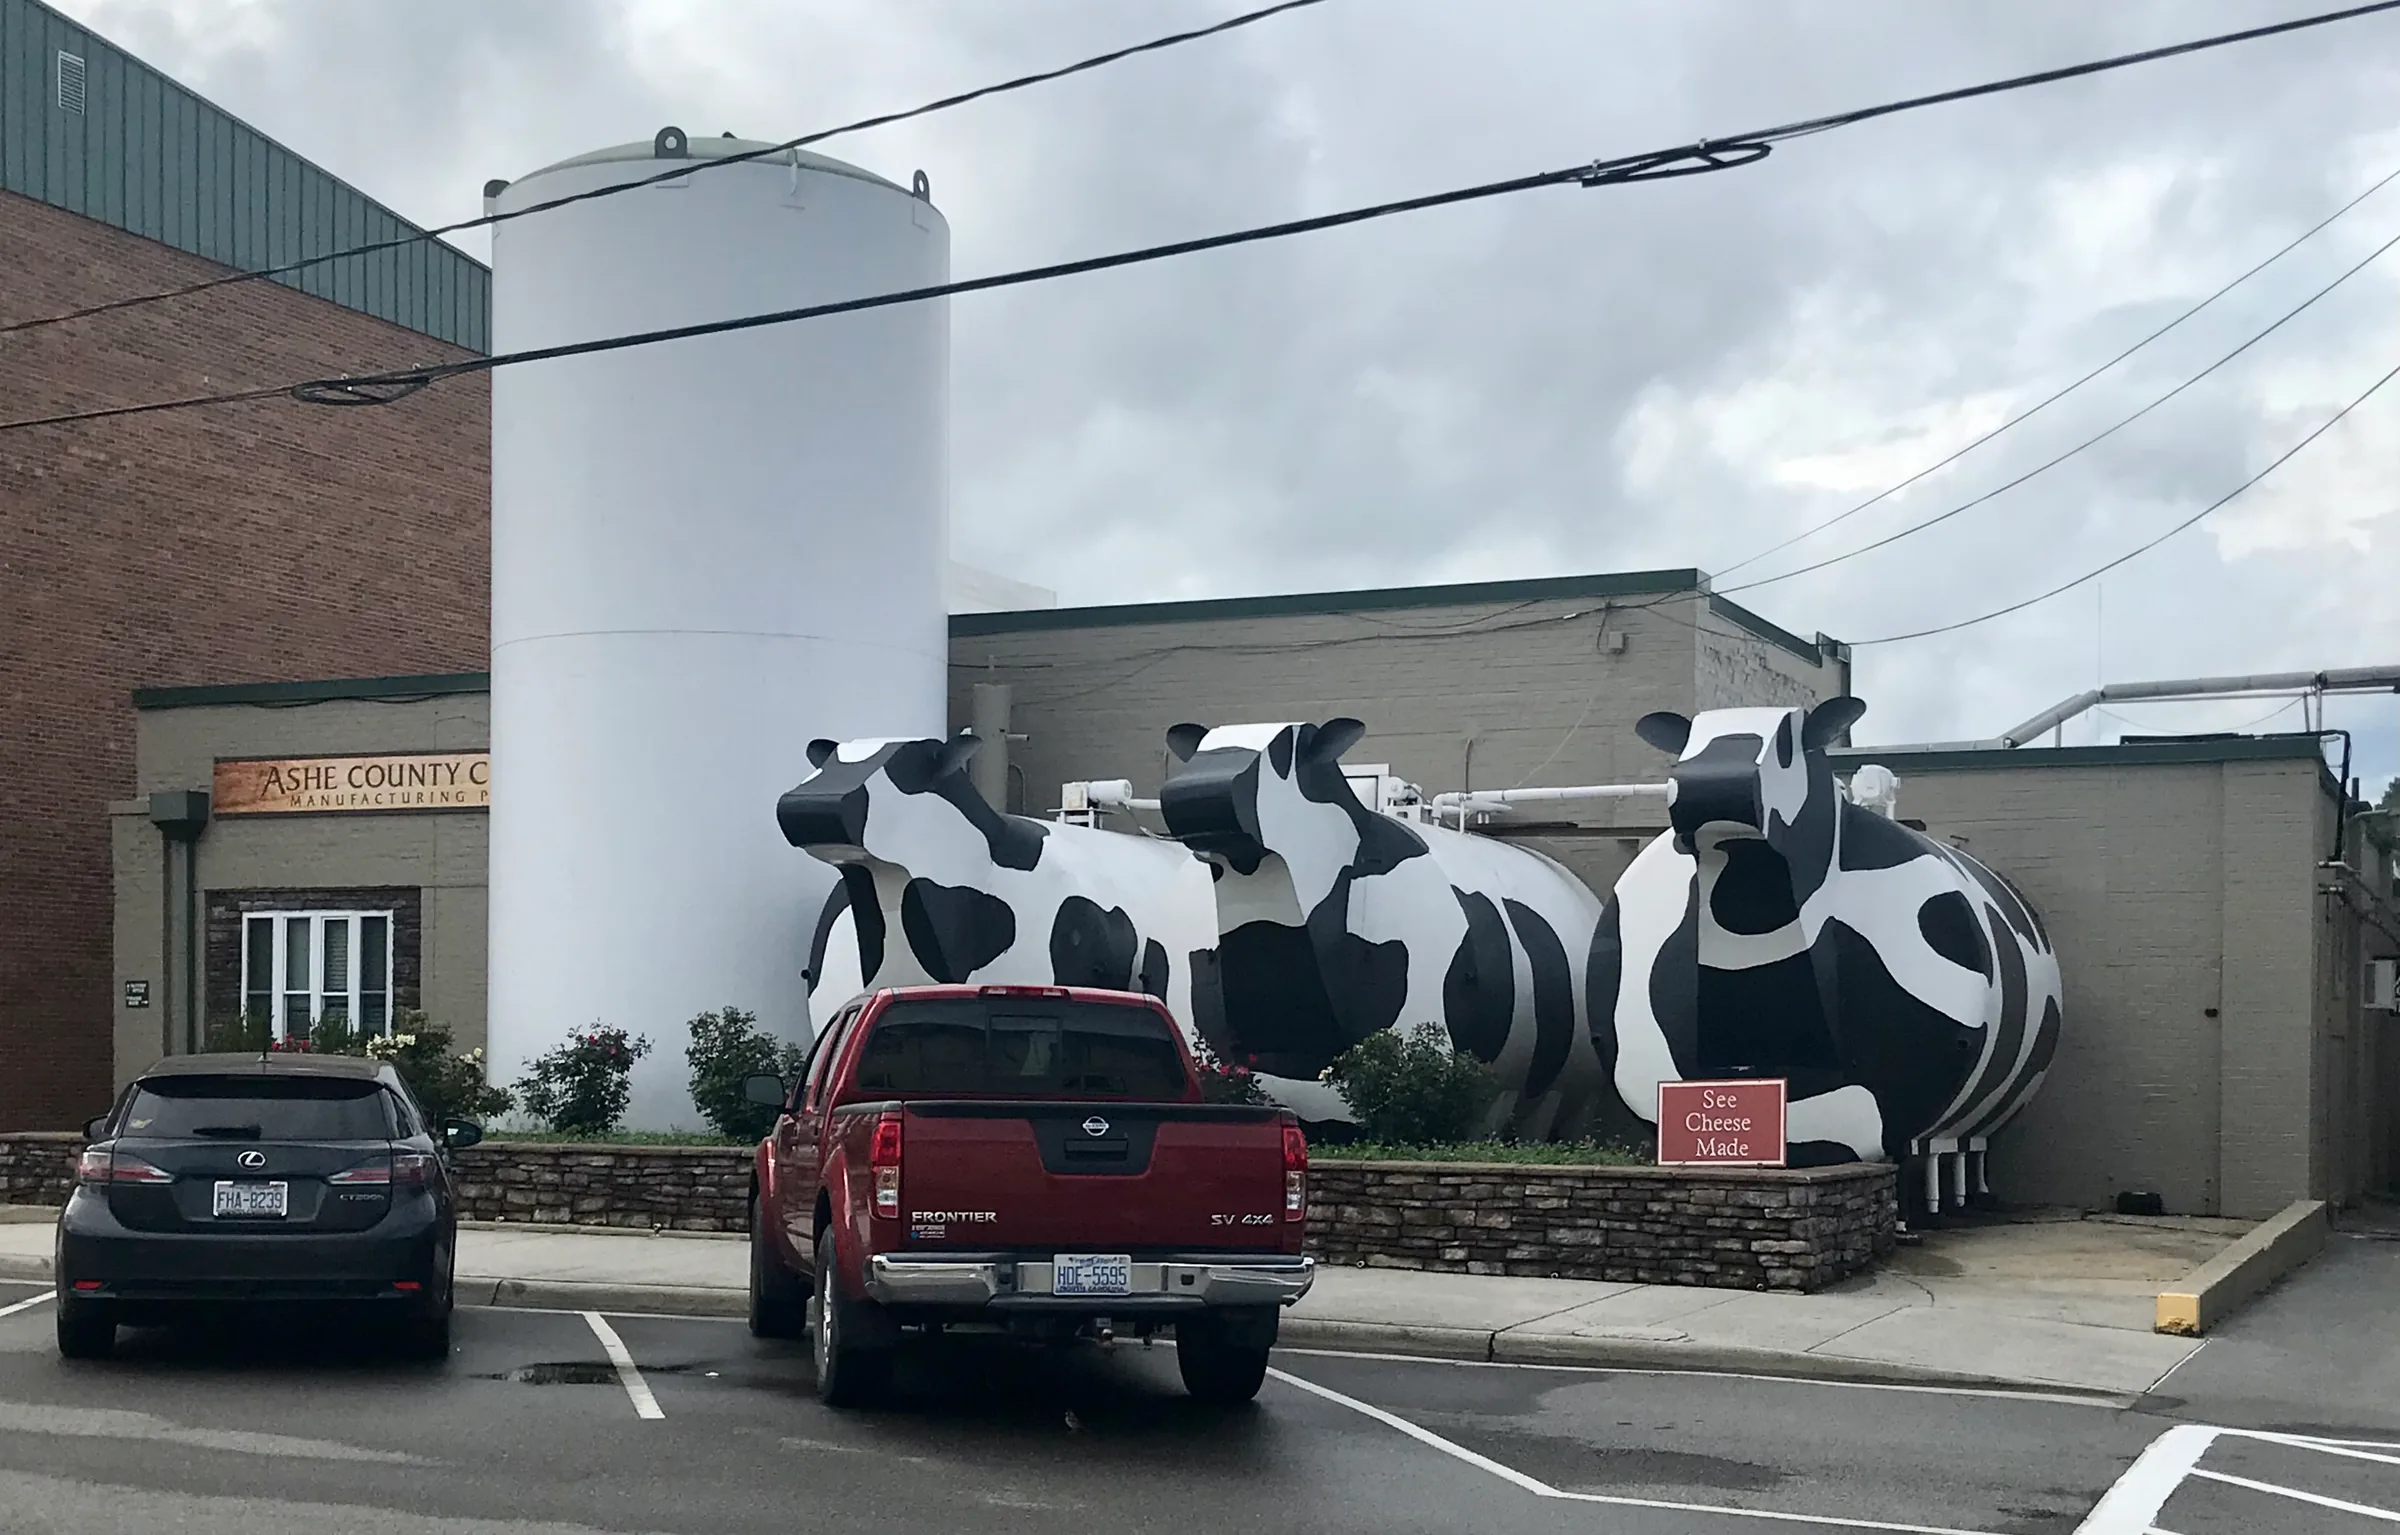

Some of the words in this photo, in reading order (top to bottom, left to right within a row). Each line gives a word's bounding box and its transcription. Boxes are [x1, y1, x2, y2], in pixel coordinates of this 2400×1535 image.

[261, 766, 337, 797] ASHE
[347, 763, 461, 789] COUNTY
[290, 791, 466, 808] MANUFACTURING
[1702, 1089, 1737, 1109] See
[1685, 1112, 1751, 1132] Cheese
[1695, 1137, 1749, 1157] Made
[217, 1191, 283, 1209] FHA-8239
[911, 1211, 998, 1223] FRONTIER
[1211, 1214, 1236, 1225] SV
[1057, 1266, 1127, 1286] HDE-5595
